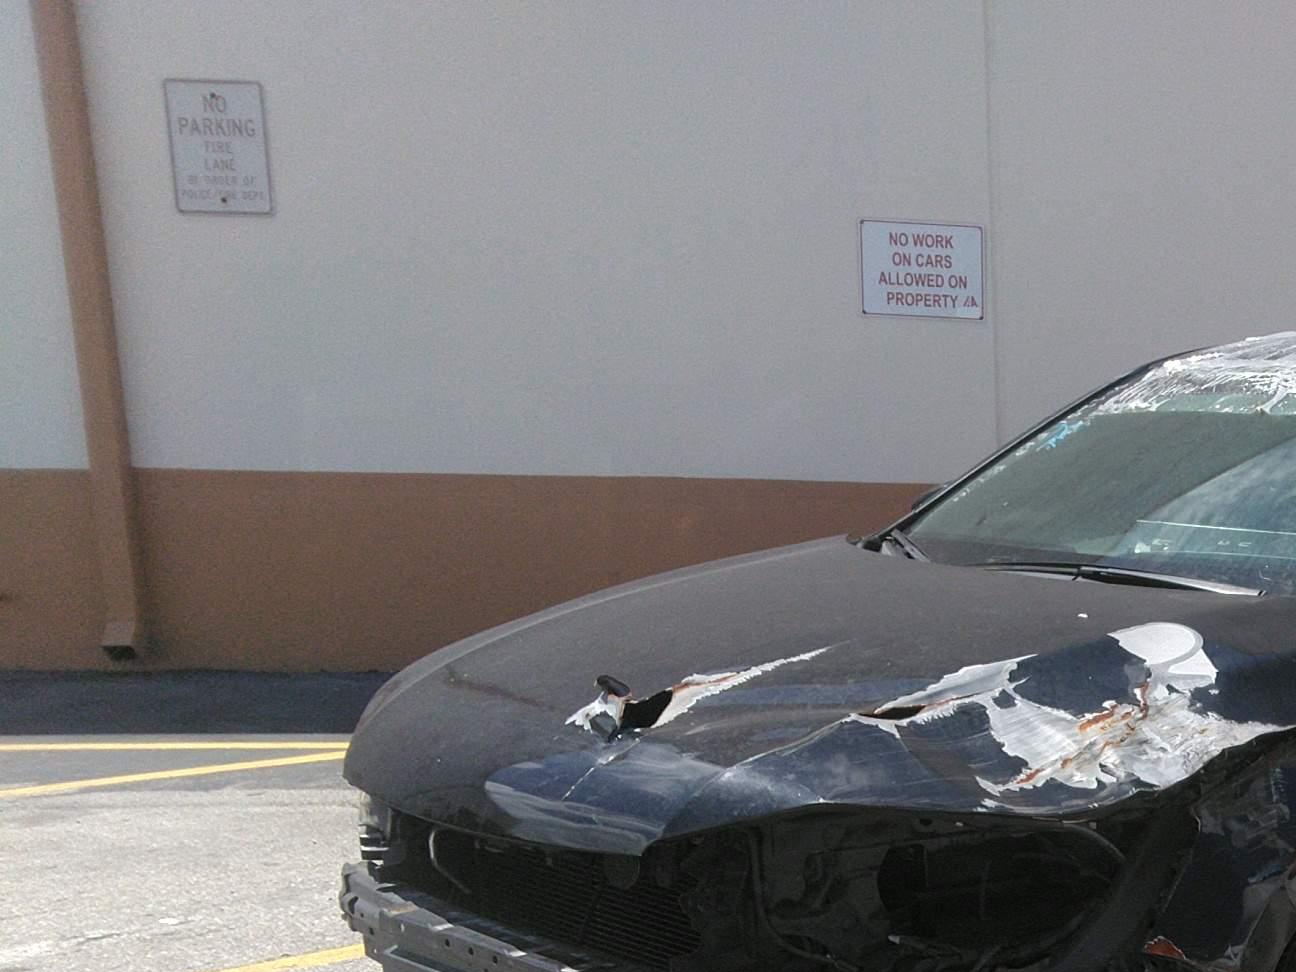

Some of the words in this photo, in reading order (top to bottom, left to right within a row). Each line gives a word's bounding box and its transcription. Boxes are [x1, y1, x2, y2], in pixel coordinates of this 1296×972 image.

[202, 95, 226, 113] NO
[177, 117, 256, 137] PARKING
[204, 141, 233, 154] FIRE
[204, 159, 236, 171] LANE
[889, 232, 908, 247] NO
[912, 233, 954, 249] WORK
[892, 252, 911, 266] ON
[916, 254, 952, 268] CARS
[879, 271, 944, 288] ALLOWED
[948, 275, 967, 288] ON
[887, 292, 958, 308] PROPERTY
